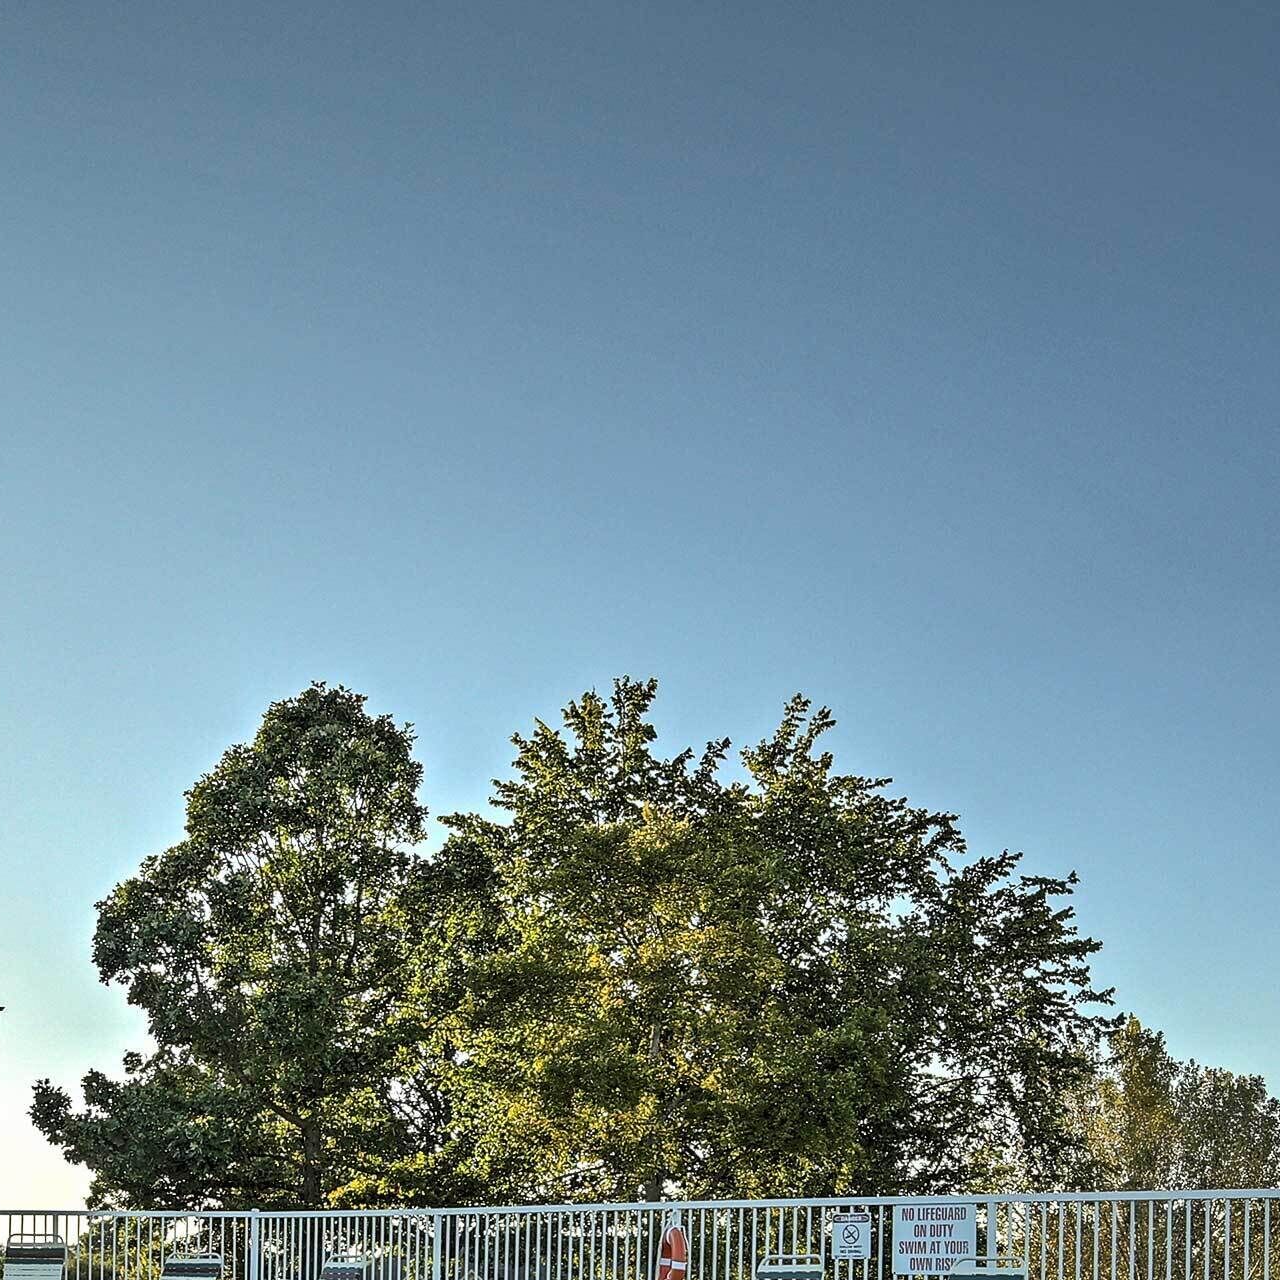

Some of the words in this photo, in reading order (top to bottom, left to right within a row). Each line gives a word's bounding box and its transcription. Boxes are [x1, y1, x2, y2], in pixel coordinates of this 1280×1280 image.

[901, 1207, 915, 1221] NO
[917, 1207, 967, 1221] LIFEGUARD
[914, 1224, 927, 1238] ON
[930, 1224, 954, 1238] DUTY
[899, 1241, 927, 1255] SWIM
[930, 1241, 941, 1255] AT
[944, 1241, 969, 1255] YOUR
[910, 1257, 933, 1271] OWN
